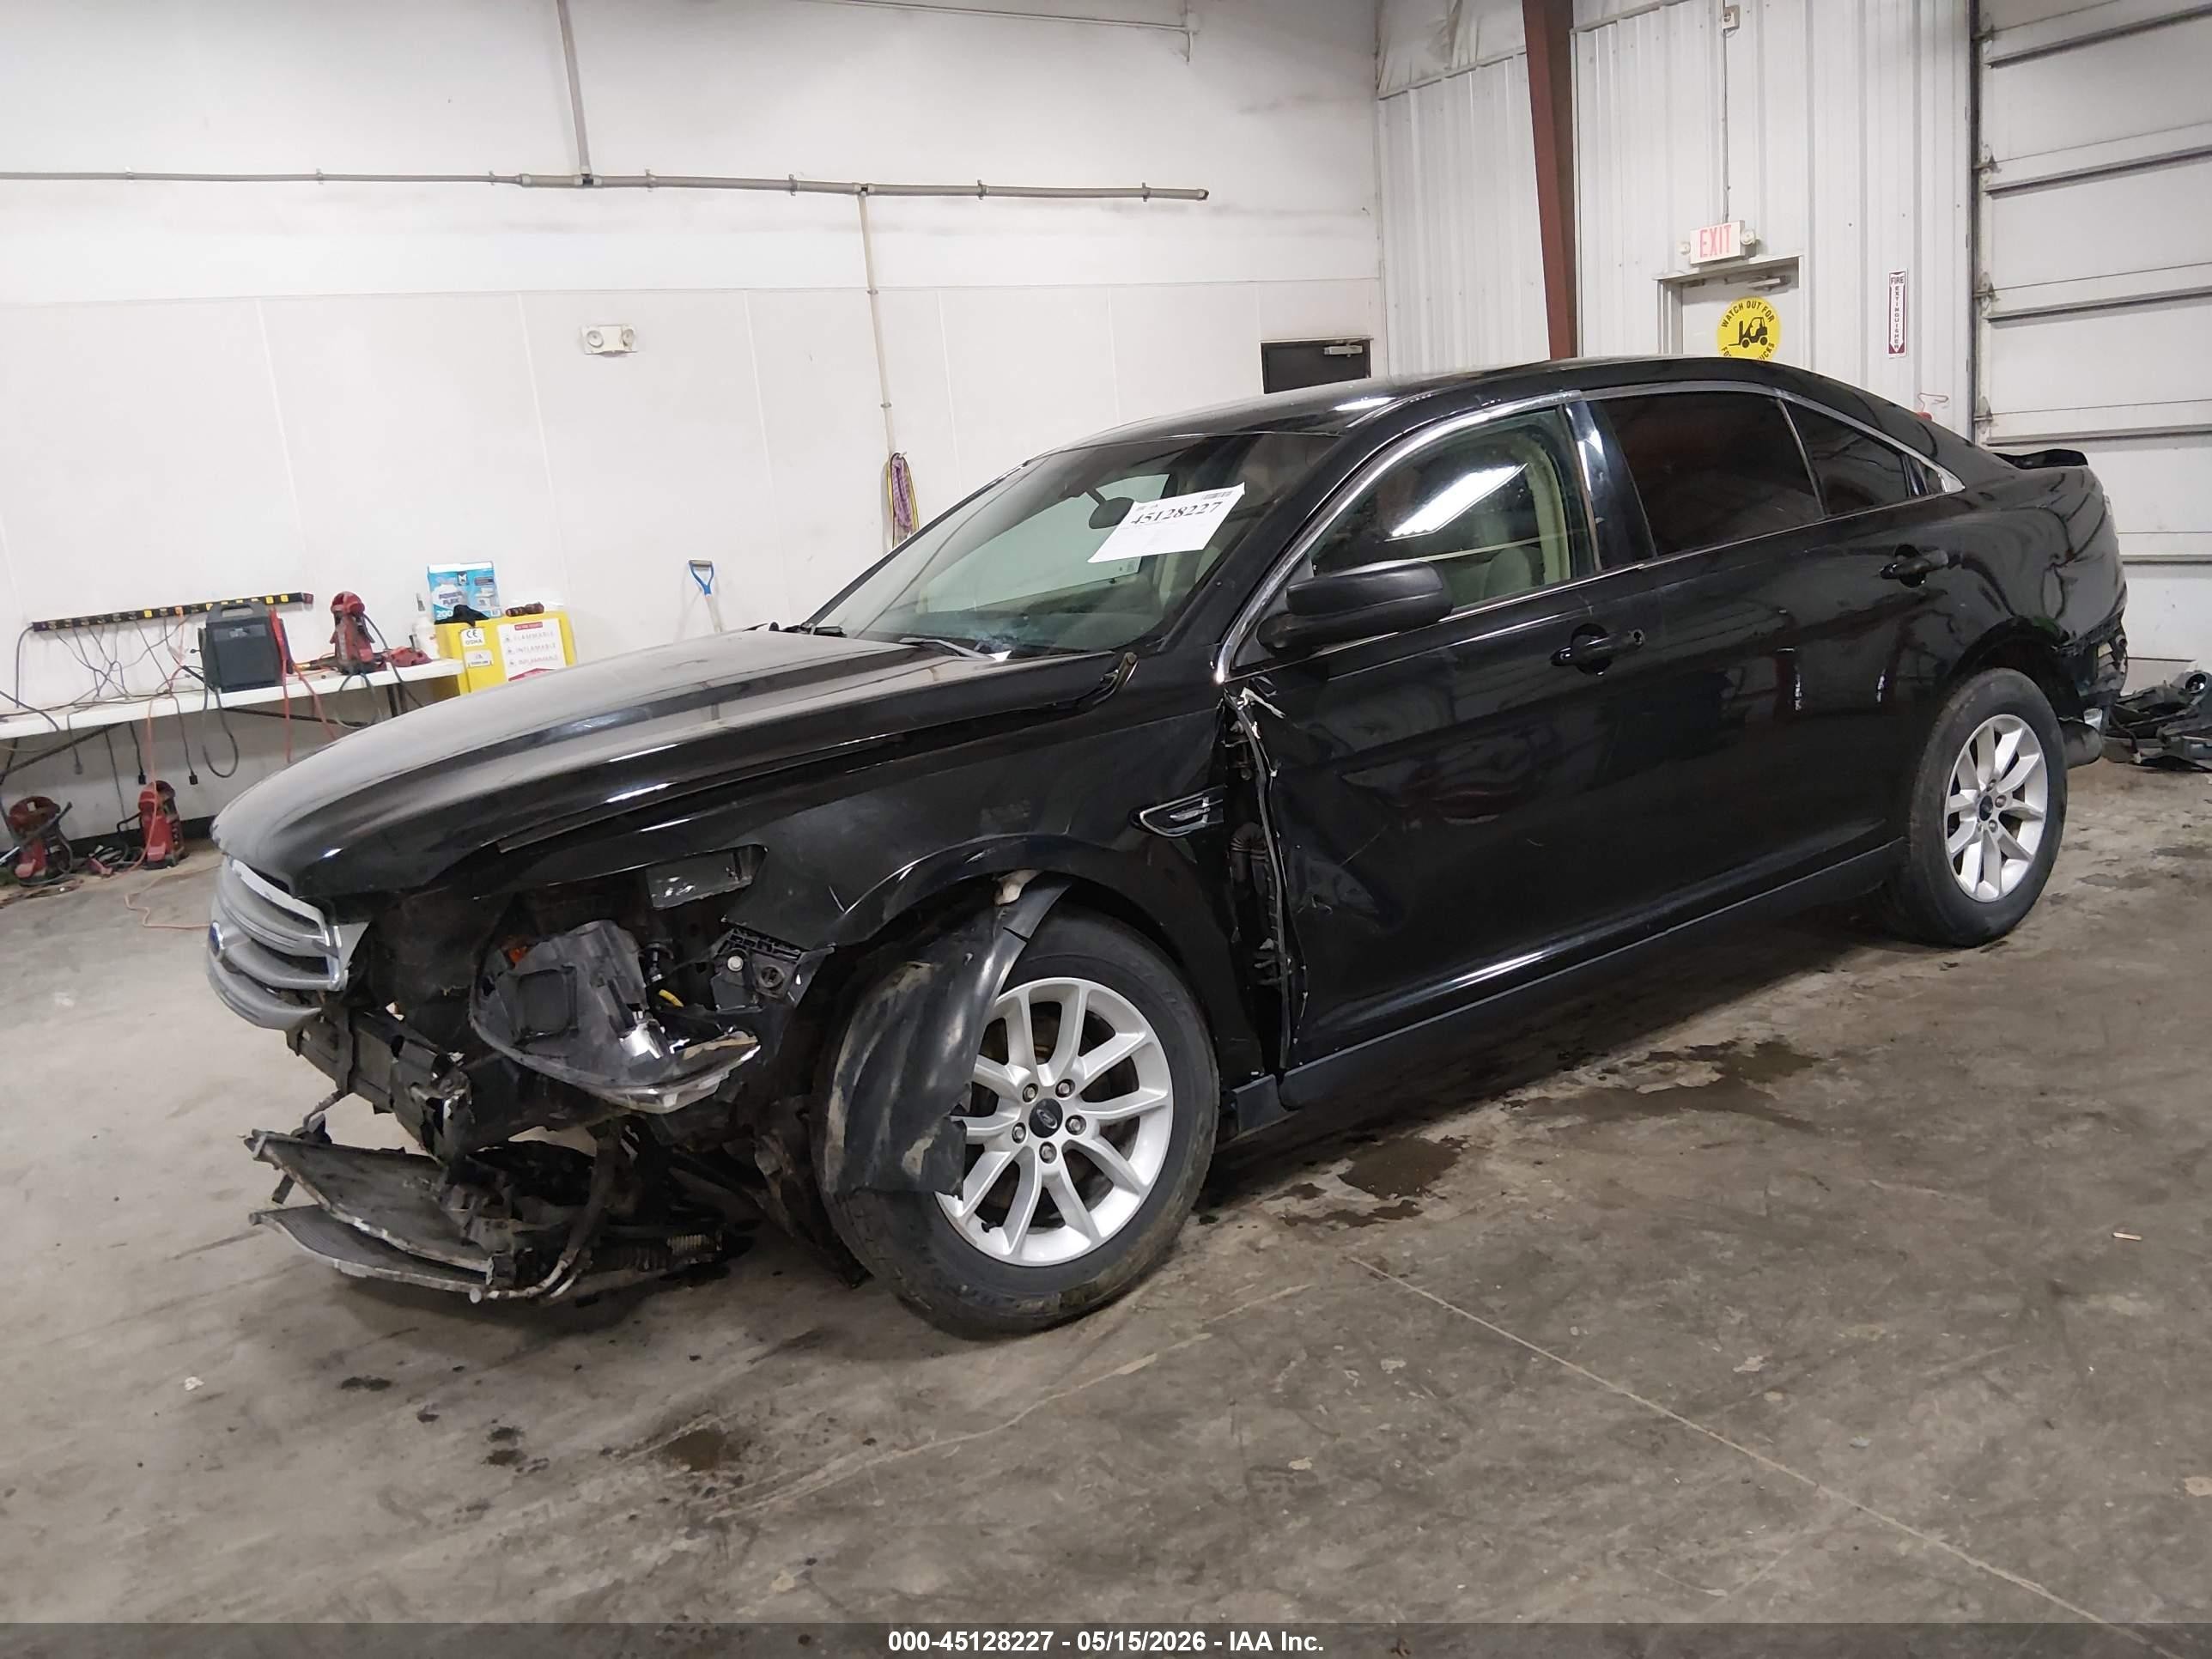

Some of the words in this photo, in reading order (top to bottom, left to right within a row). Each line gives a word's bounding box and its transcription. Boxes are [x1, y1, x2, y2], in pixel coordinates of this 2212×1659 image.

[1700, 224, 1731, 258] EXIT
[1891, 276, 1904, 284] FIRE
[1721, 302, 1744, 327] WATCH
[1746, 301, 1762, 310] OUT
[1761, 306, 1775, 322] FOR
[1131, 501, 1223, 524] 45128227
[466, 629, 477, 639] CE
